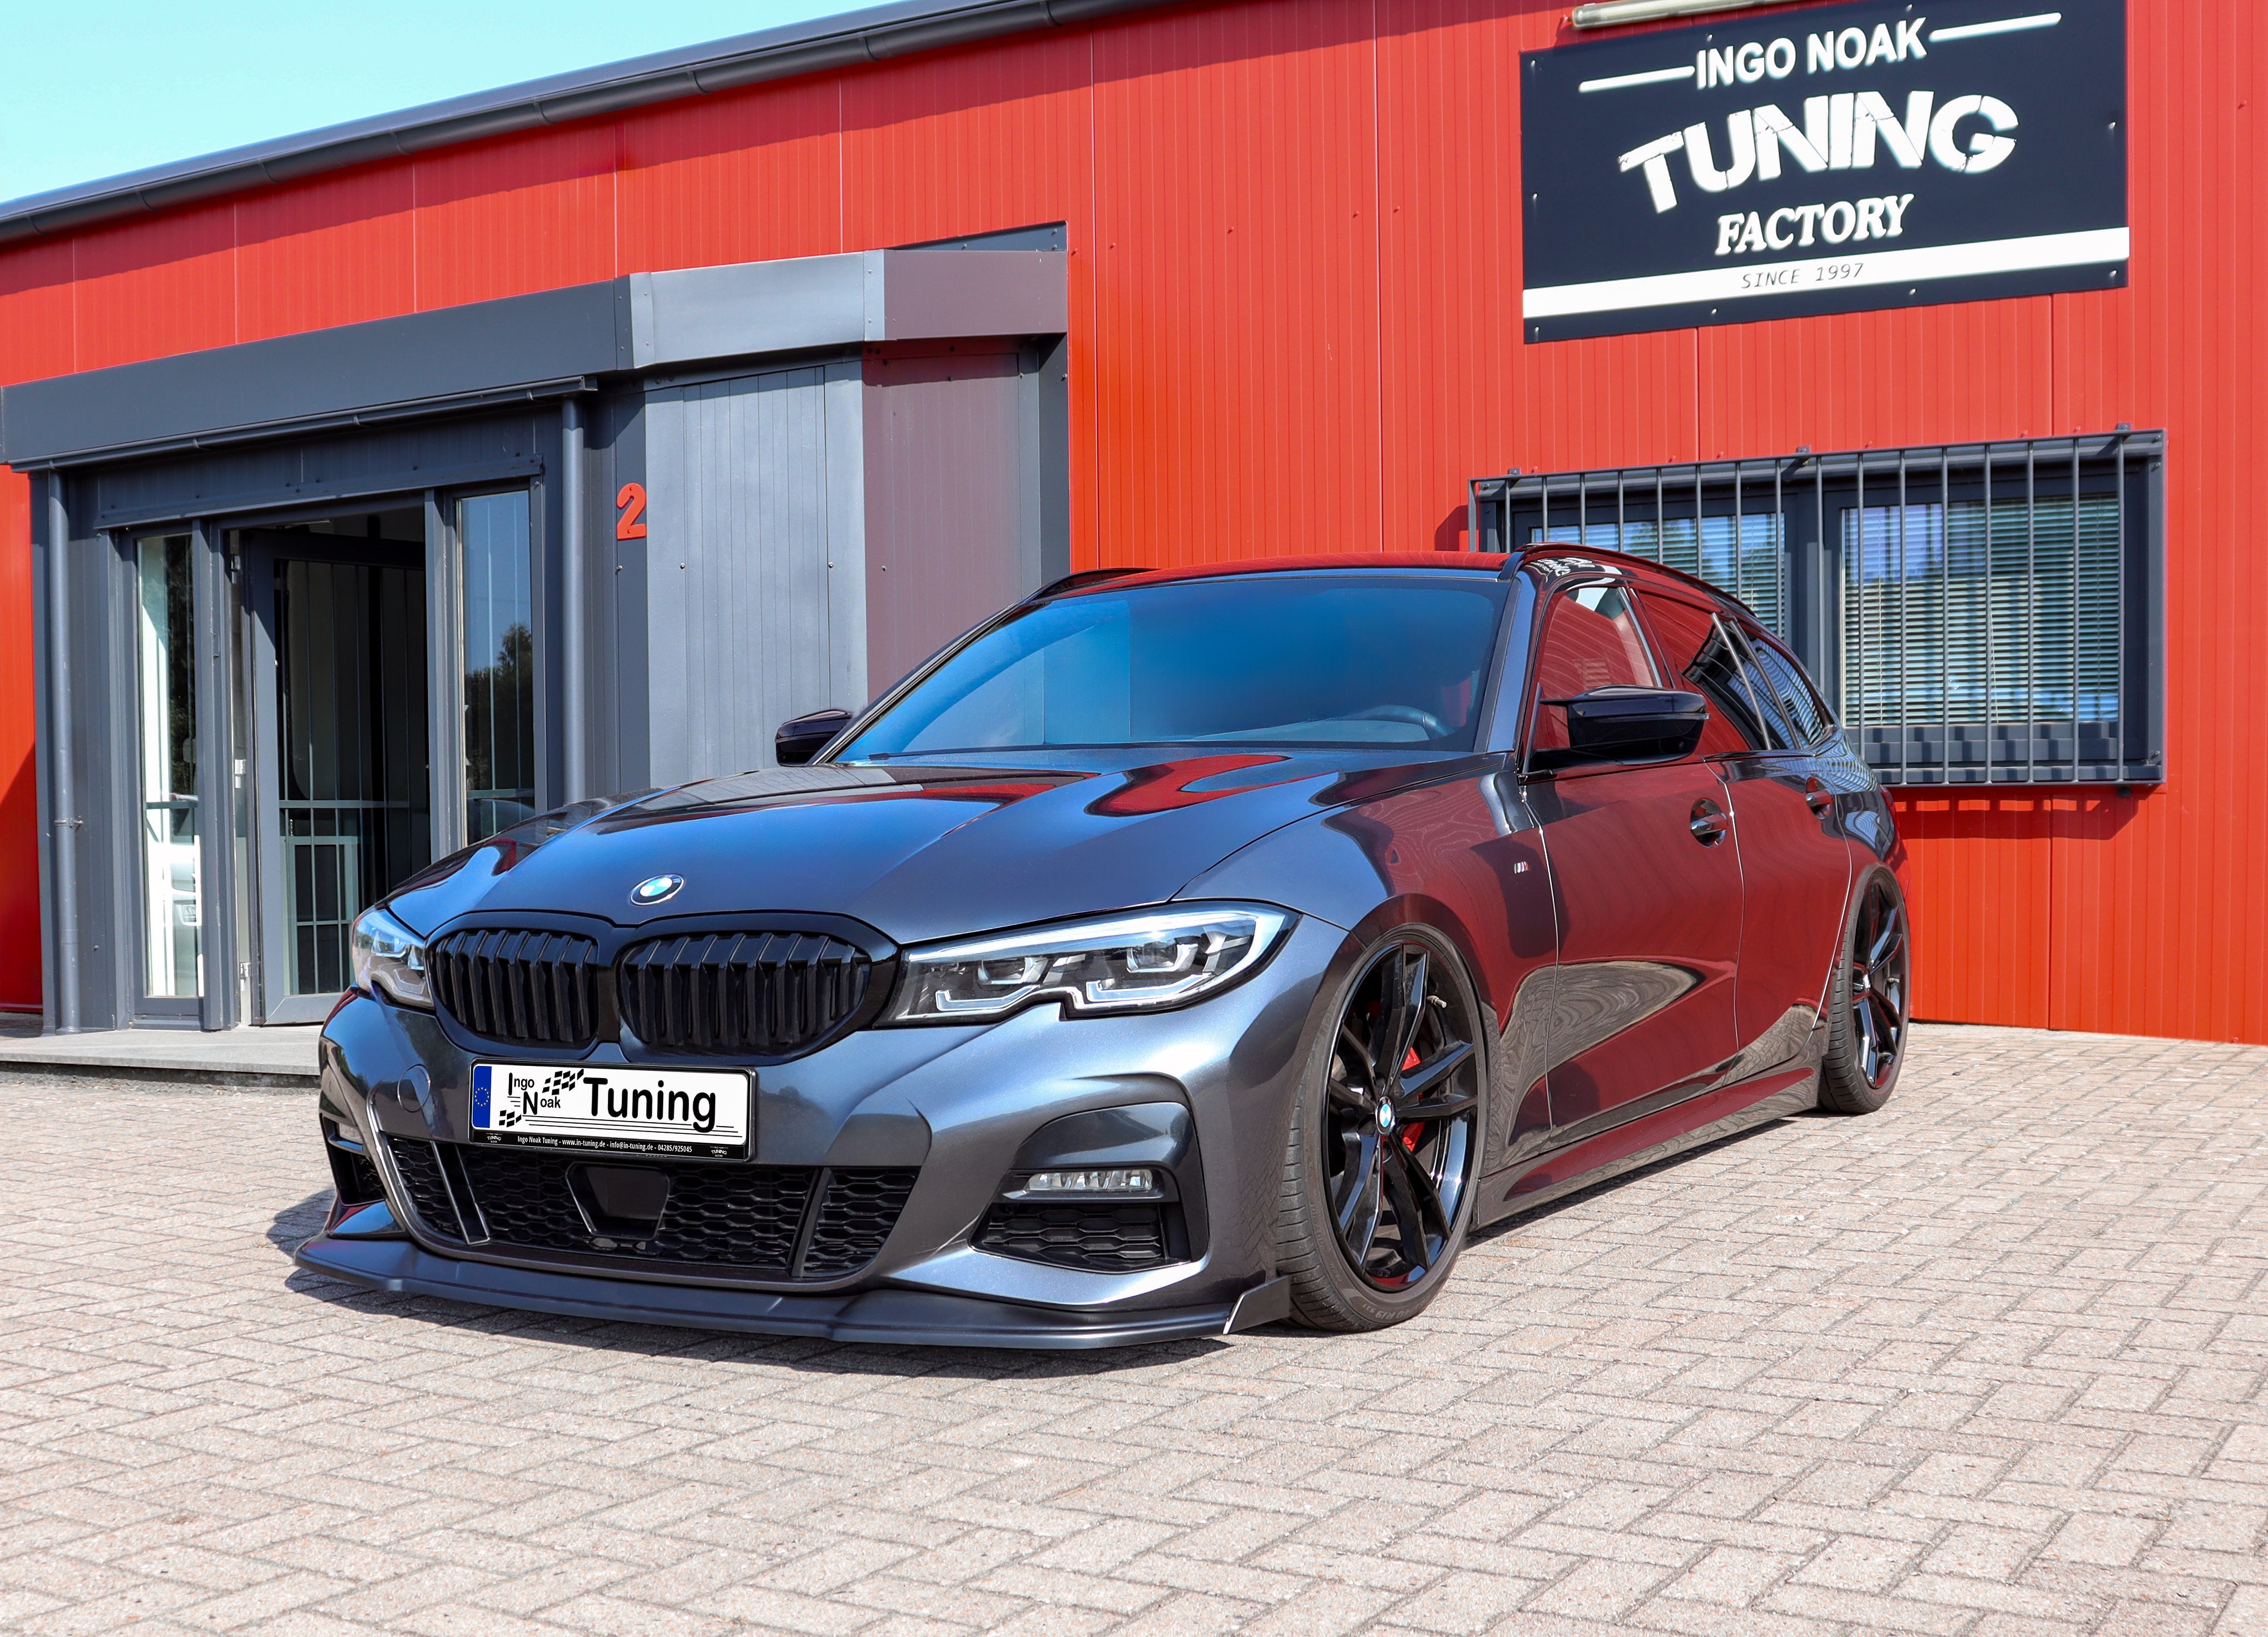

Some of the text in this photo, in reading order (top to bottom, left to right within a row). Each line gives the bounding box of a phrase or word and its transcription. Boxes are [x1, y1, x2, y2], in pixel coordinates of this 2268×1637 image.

[1697, 17, 1927, 89] INGO NOAK
[1618, 90, 2019, 214] TUNING
[1715, 194, 1914, 255] FACTORY
[1741, 262, 1864, 289] SINCE 1997
[617, 482, 647, 540] 2
[508, 1072, 535, 1096] Ingo
[522, 1091, 561, 1115] Noak
[583, 1077, 716, 1133] Tuning
[517, 1135, 528, 1144] Ingo
[529, 1136, 542, 1144] Noak
[542, 1137, 558, 1146] Tuning
[562, 1139, 606, 1149] www.in-tuning.de
[610, 1141, 653, 1152] info@in-tuning.de
[657, 1144, 692, 1153] 04285/925045
